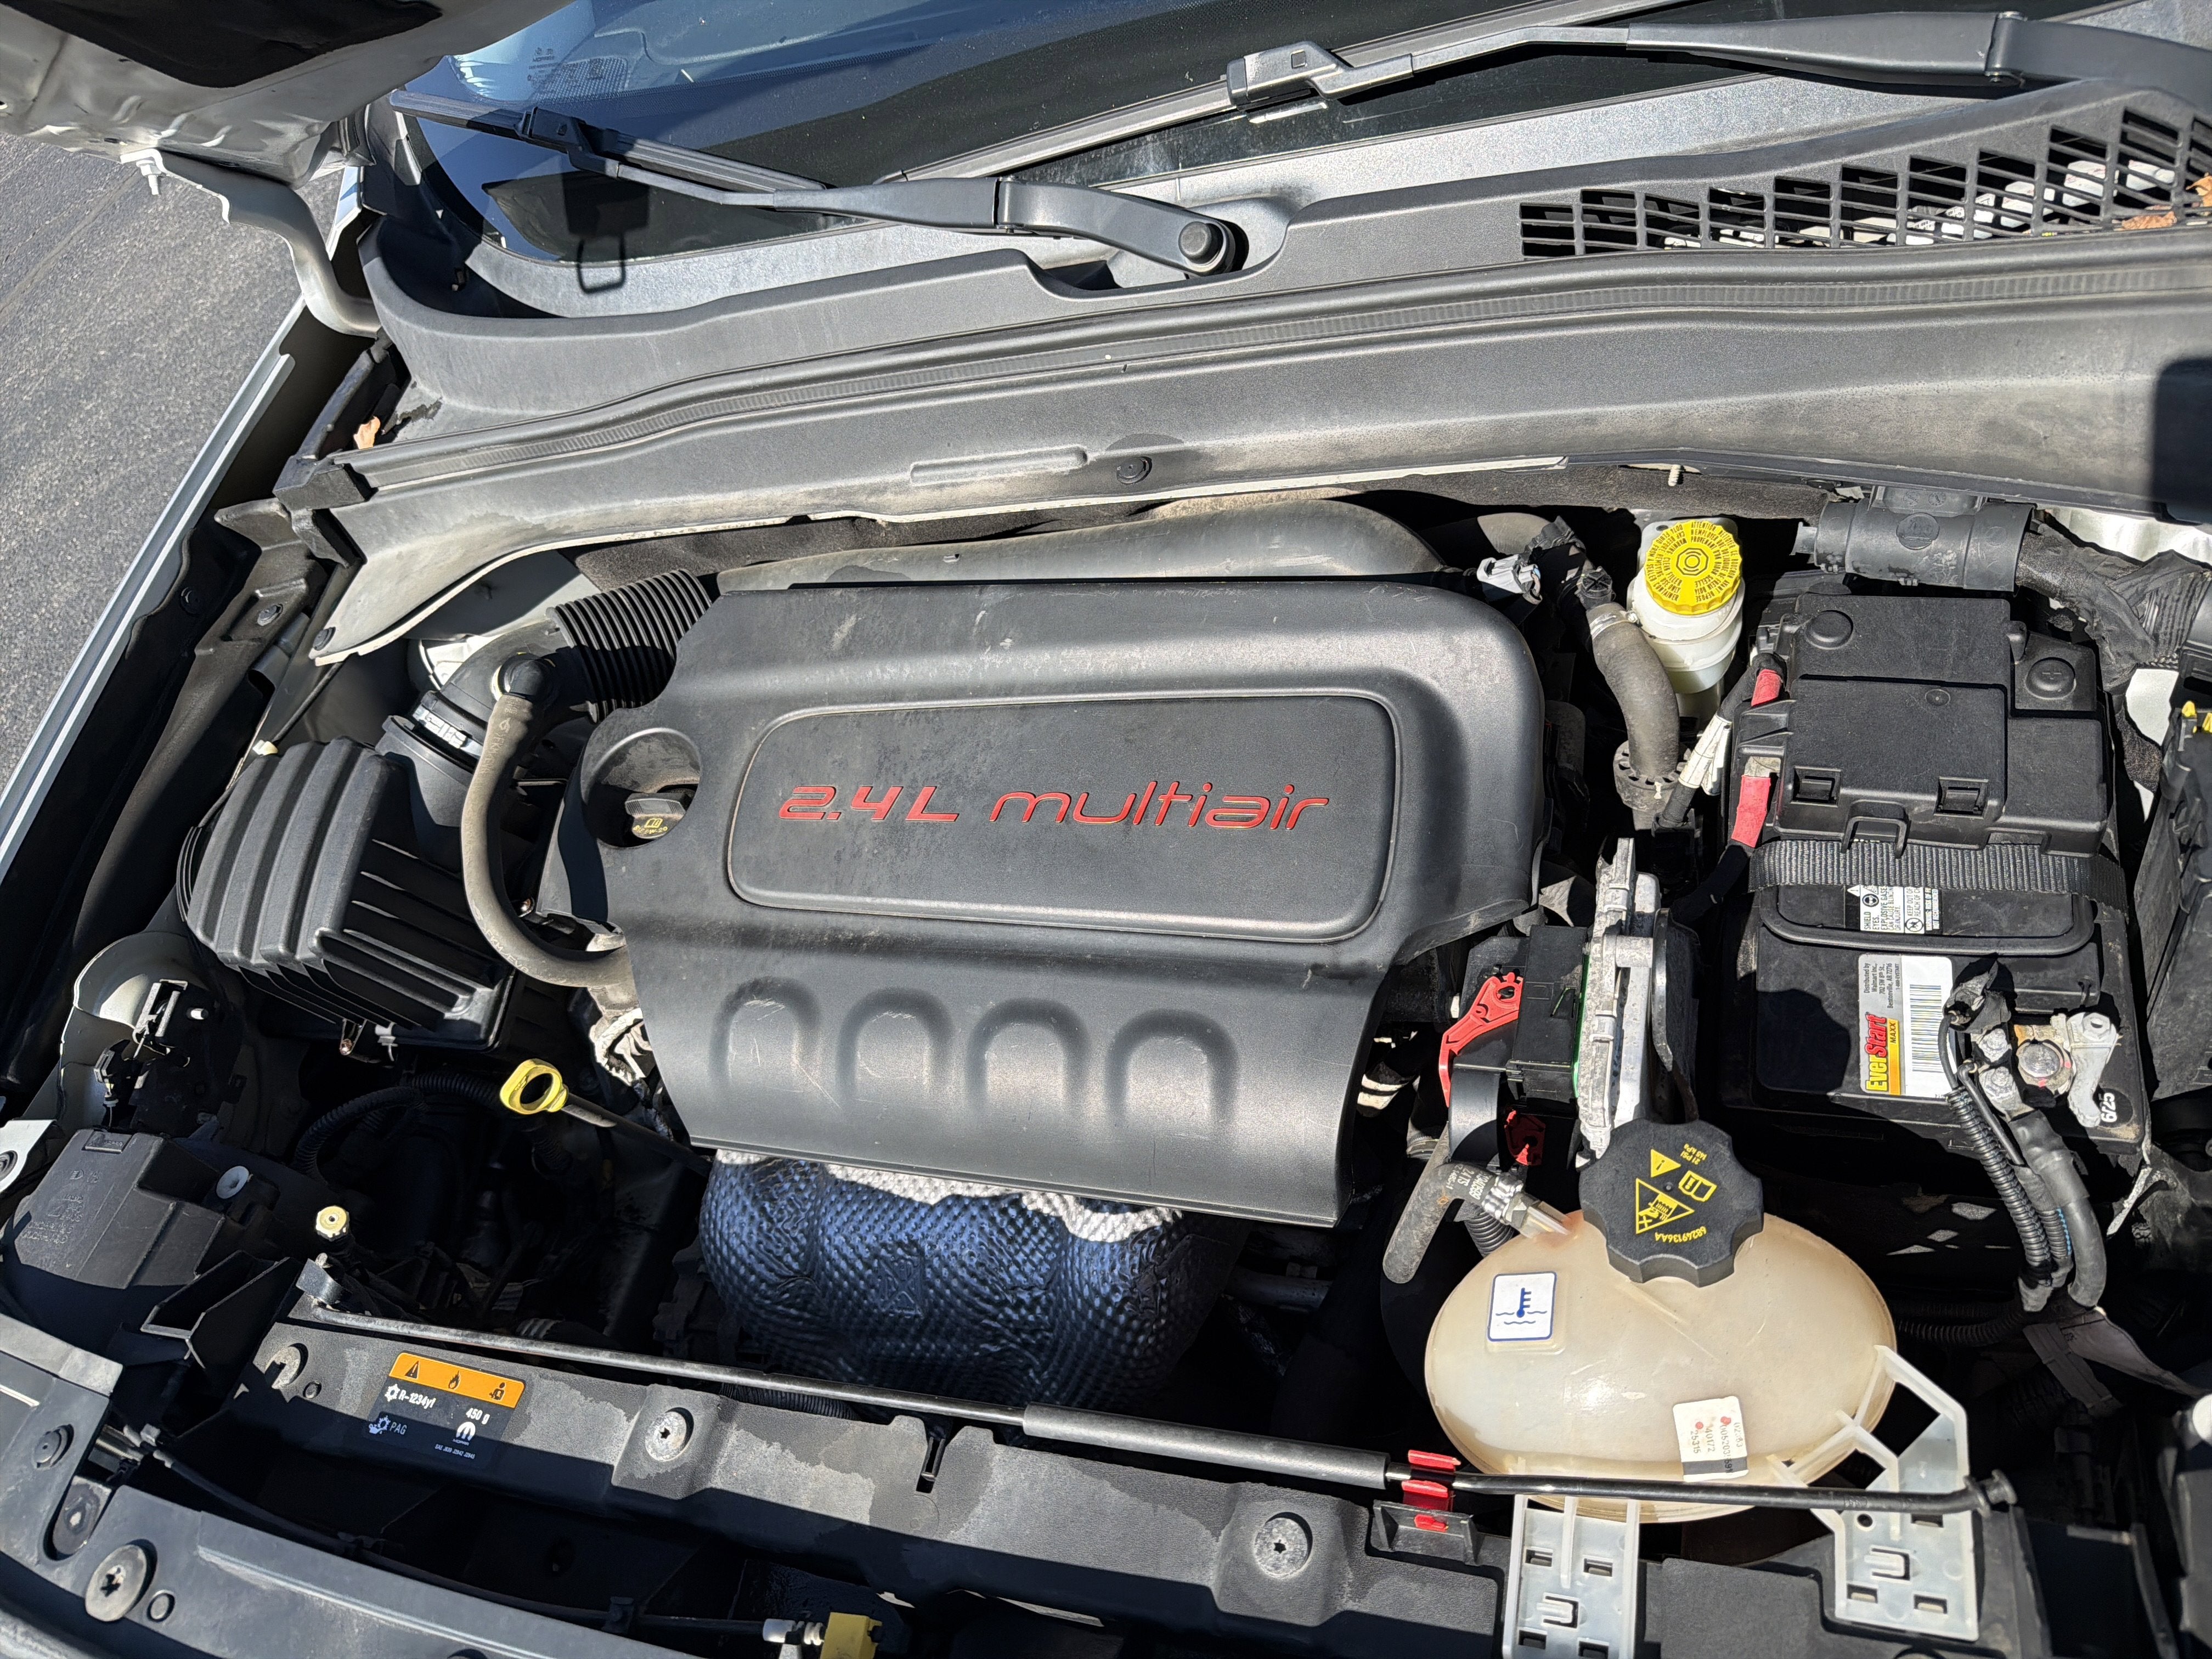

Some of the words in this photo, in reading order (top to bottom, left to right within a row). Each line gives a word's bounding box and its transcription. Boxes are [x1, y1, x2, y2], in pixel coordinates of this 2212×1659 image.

[1670, 524, 1683, 534] DOT4
[1656, 532, 1670, 544] FLUID
[1691, 536, 1717, 550] PROVENANT
[1648, 544, 1660, 557] FROM
[1658, 536, 1675, 552] BEFORE
[1668, 584, 1681, 593] ONLY
[1663, 557, 1671, 571] CLEAN
[1646, 564, 1657, 582] SEALED
[1666, 572, 1683, 586] FILLER
[1707, 578, 1721, 590] FREIN
[1716, 579, 1730, 594] AVANT
[1653, 582, 1679, 601] CONTAINER
[989, 780, 1330, 831] multiair
[1865, 1013, 1888, 1092] EverStart
[2098, 1092, 2118, 1123] 6/25
[1680, 1150, 1693, 1161] PSI
[1684, 1143, 1697, 1155] kPa
[1691, 1156, 1700, 1165] 21
[1655, 1226, 1707, 1242] 68249136AA
[398, 1390, 437, 1409] R-1234yf
[466, 1407, 483, 1420] 450
[481, 1413, 490, 1425] g
[390, 1421, 408, 1435] PAG
